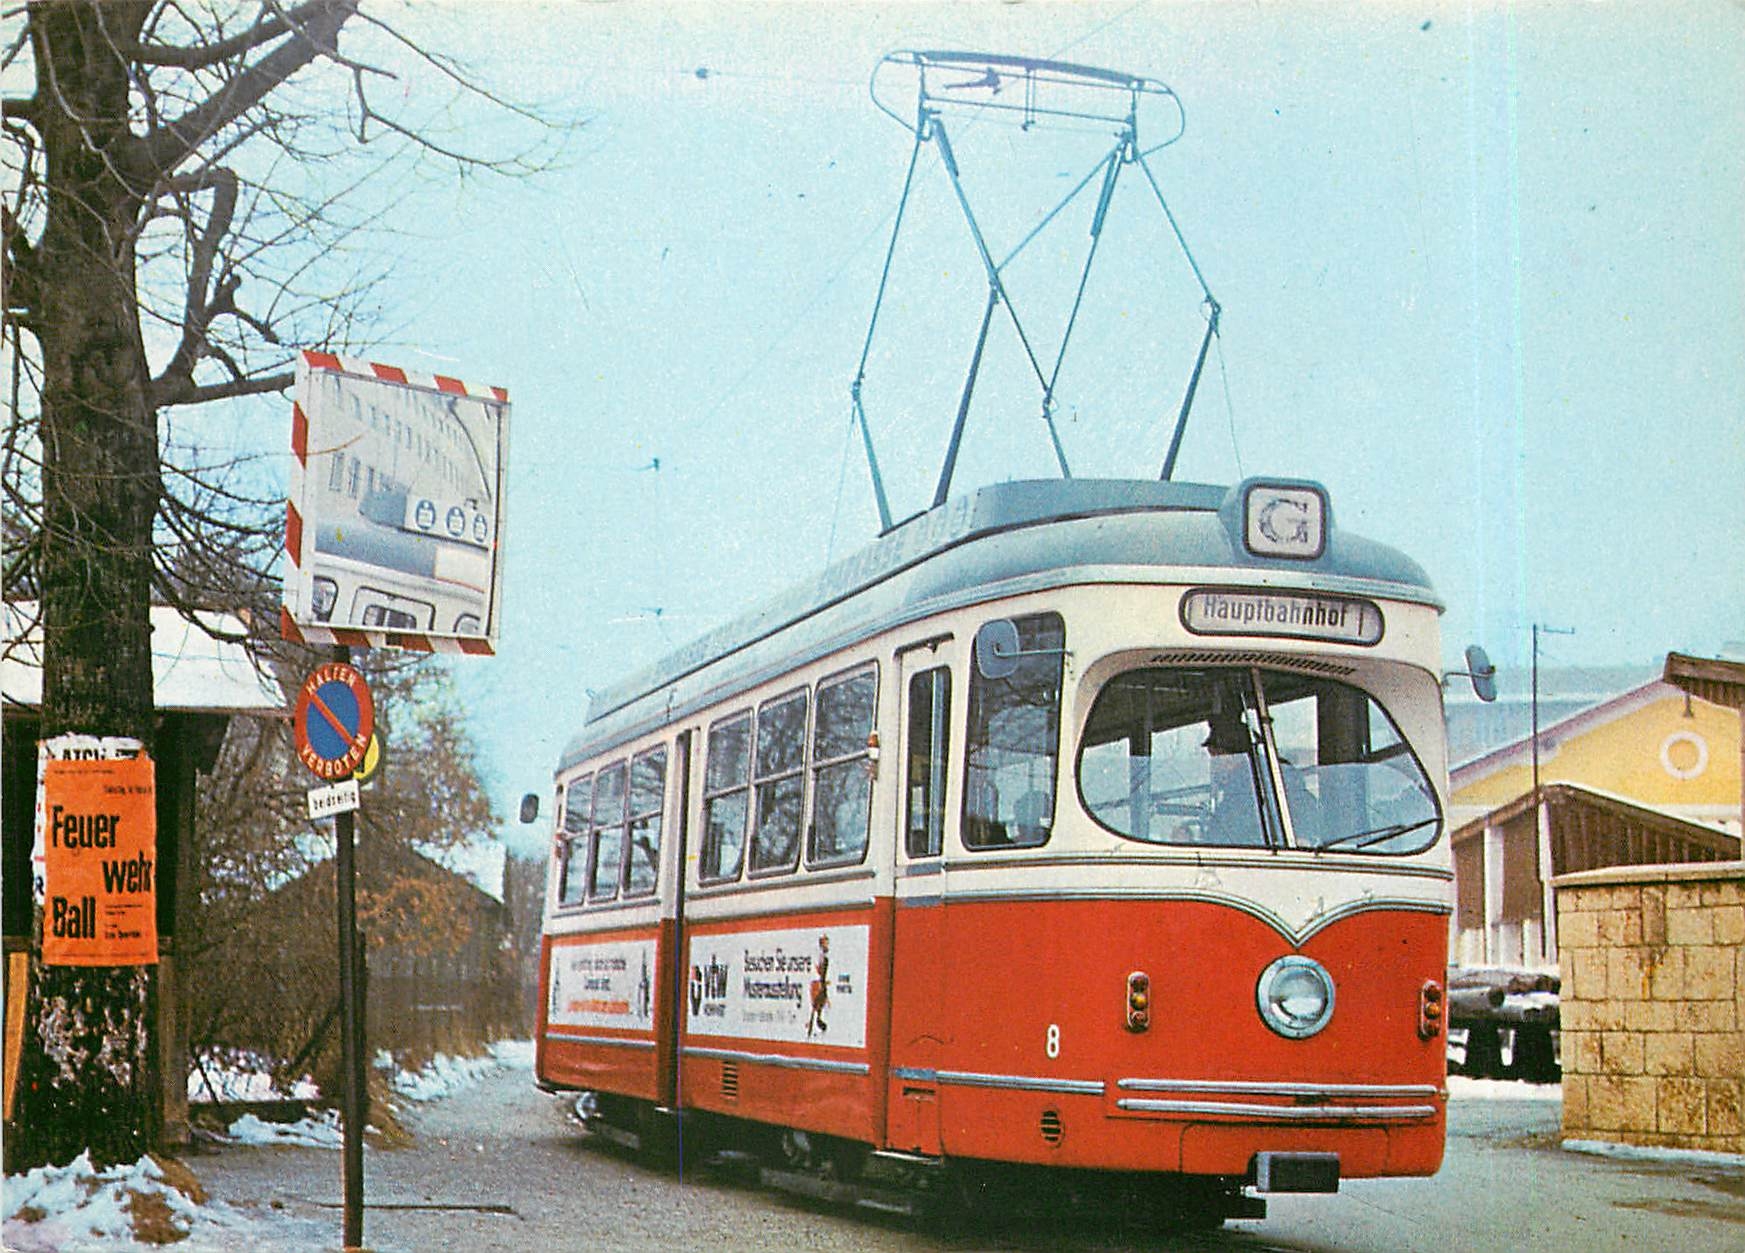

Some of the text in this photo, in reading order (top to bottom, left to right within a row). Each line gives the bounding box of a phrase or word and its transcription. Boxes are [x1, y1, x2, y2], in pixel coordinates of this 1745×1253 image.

[1259, 498, 1308, 543] G
[1204, 593, 1347, 627] Hauptbahnhof
[305, 666, 357, 695] HALTEN
[302, 733, 367, 776] VERBOTEN
[52, 805, 120, 849] Feuer
[52, 896, 96, 939] Ball
[1047, 1023, 1060, 1059] 8
